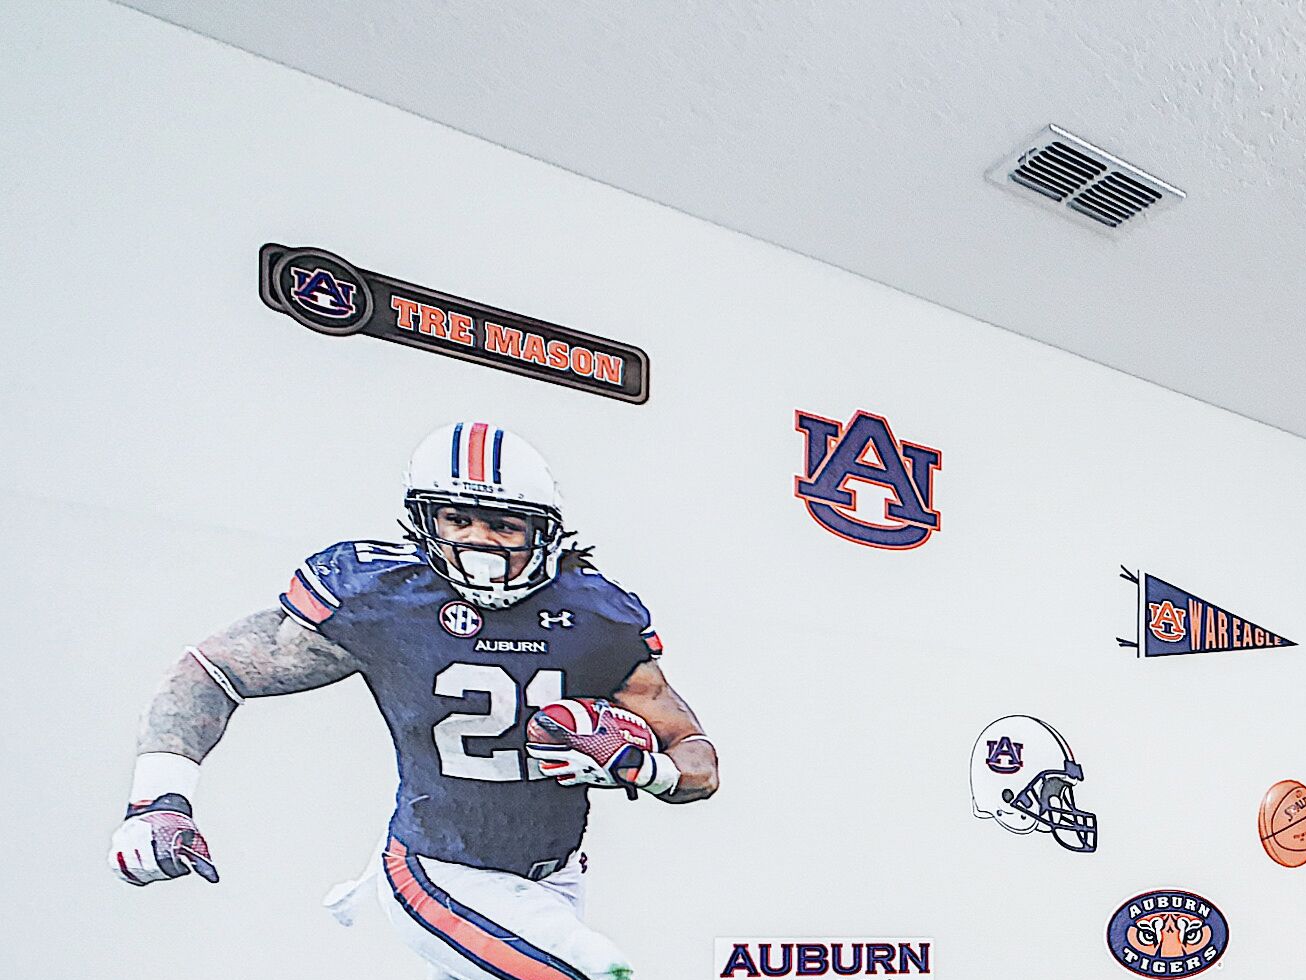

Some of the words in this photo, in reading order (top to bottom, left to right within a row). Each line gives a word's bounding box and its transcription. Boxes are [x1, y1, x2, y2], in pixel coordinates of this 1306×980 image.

[391, 295, 474, 346] TRE
[485, 321, 623, 385] MASON
[444, 604, 480, 635] SEC
[1188, 598, 1228, 650] WAR
[1232, 617, 1282, 648] EAGLE
[475, 640, 546, 653] AUBURN
[1129, 896, 1211, 918] AUBURN
[720, 942, 931, 978] AUBURN
[1123, 946, 1217, 973] TIGERS
